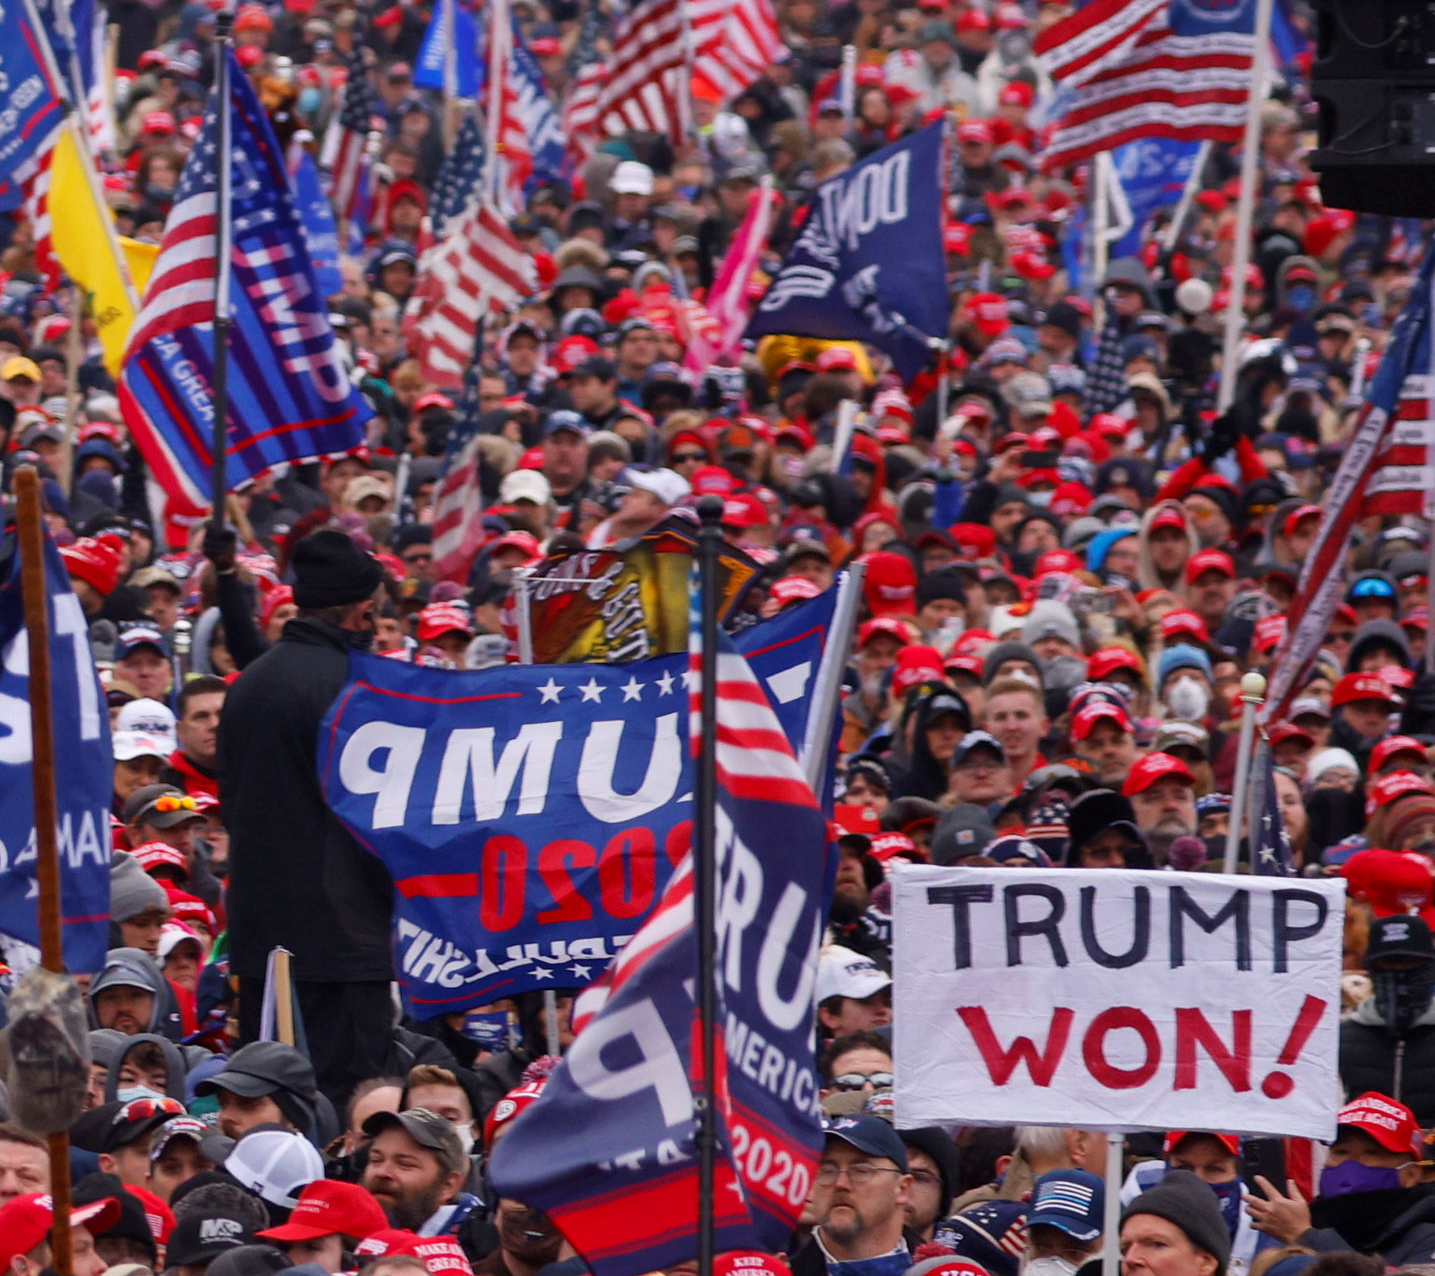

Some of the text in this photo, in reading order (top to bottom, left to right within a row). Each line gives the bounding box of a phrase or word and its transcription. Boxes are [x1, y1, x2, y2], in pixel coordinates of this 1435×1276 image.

[927, 883, 1329, 974] TRUMP
[956, 993, 1327, 1103] WON!
[730, 1126, 810, 1208] 2020
[733, 1257, 766, 1269] KEEP
